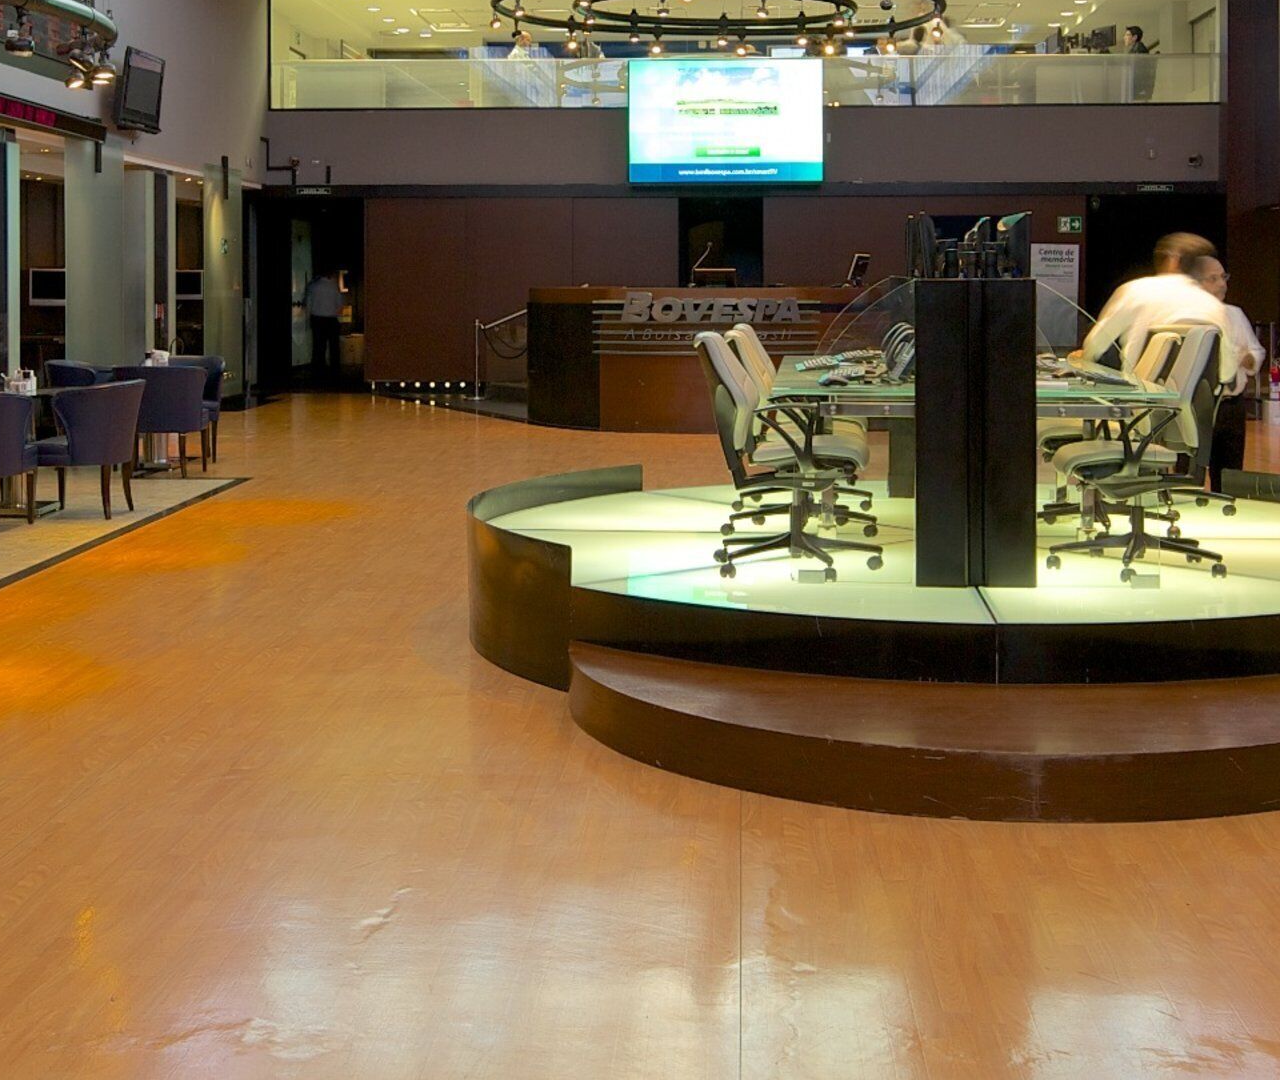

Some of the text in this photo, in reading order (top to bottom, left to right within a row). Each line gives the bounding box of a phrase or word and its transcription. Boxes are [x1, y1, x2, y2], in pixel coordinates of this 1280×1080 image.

[1038, 248, 1074, 256] Centro de
[621, 291, 800, 322] BOVESPA
[624, 329, 635, 340] A
